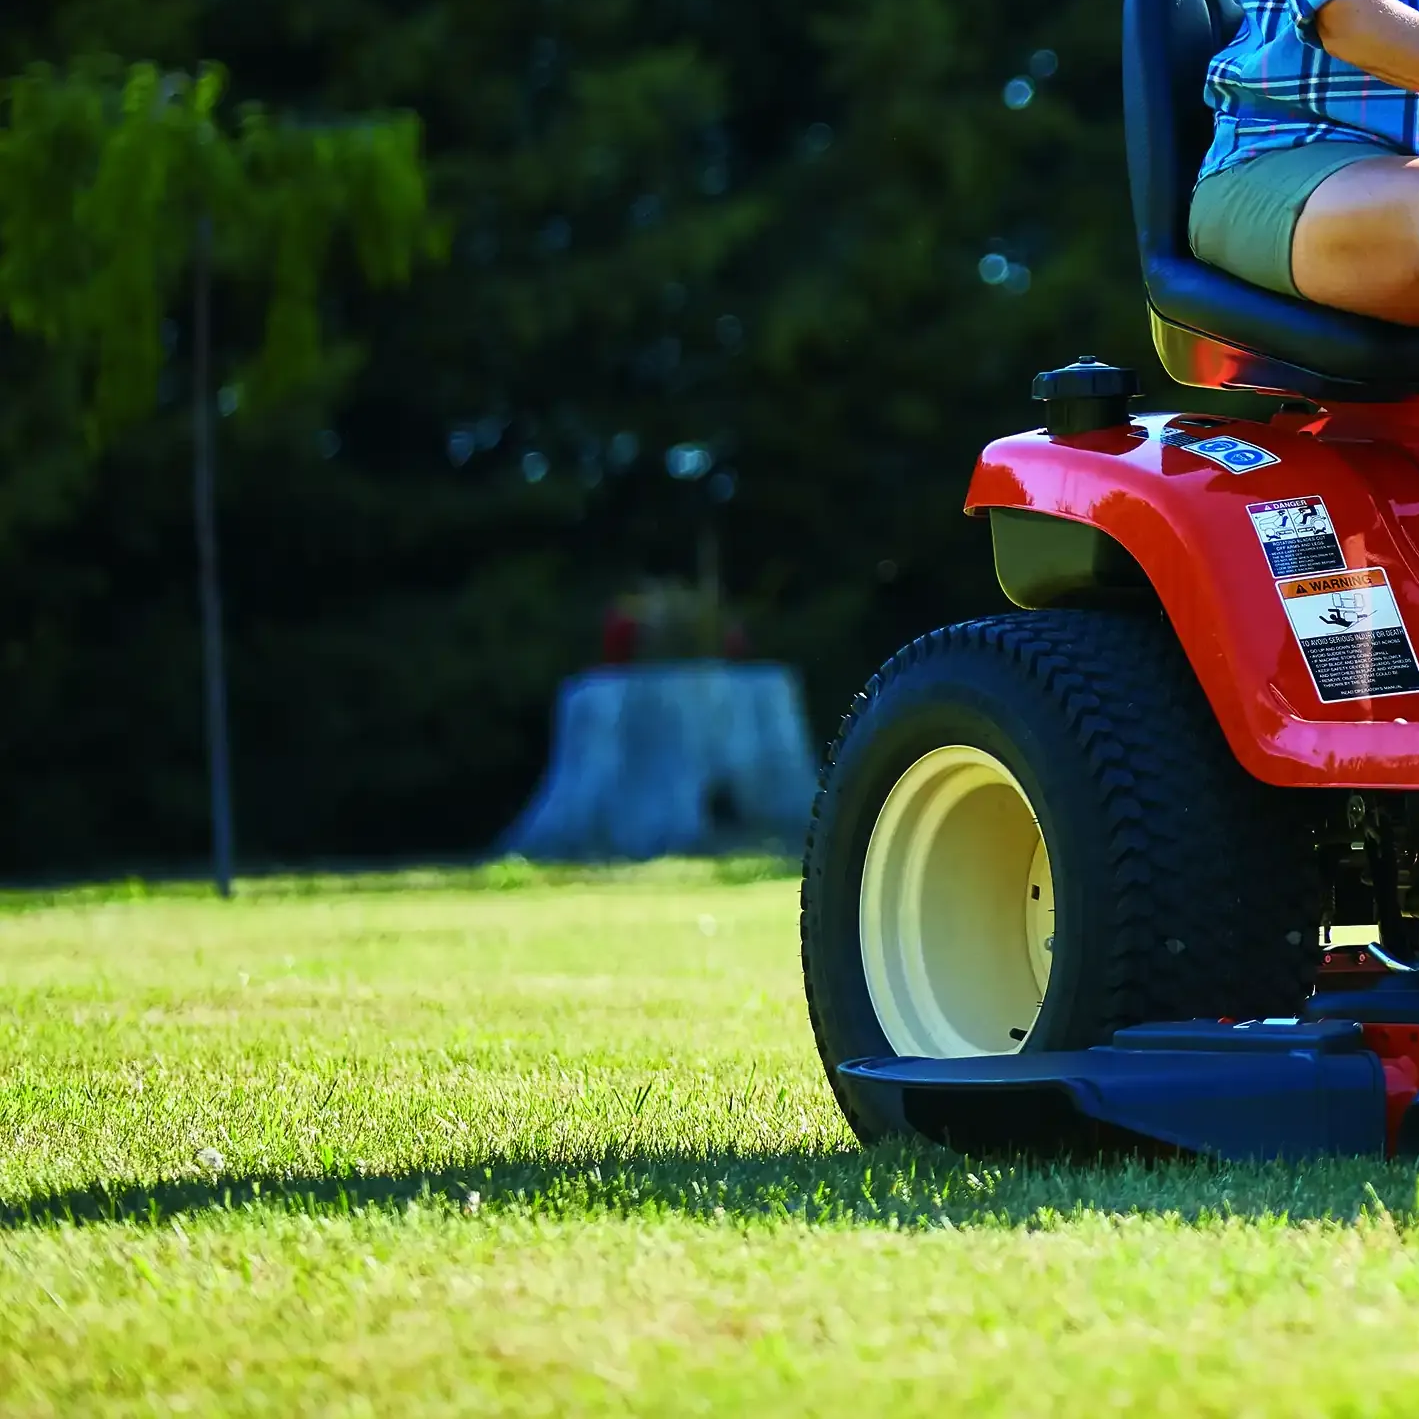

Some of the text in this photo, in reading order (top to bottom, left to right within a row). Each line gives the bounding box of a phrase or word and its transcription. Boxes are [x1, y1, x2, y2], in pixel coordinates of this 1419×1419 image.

[1273, 500, 1307, 509] DANGER
[1309, 574, 1373, 592] WARNING
[1301, 640, 1310, 648] TO
[1310, 638, 1329, 646] AVOID
[1328, 634, 1355, 644] SERIOUS
[1354, 631, 1376, 640] INJURY
